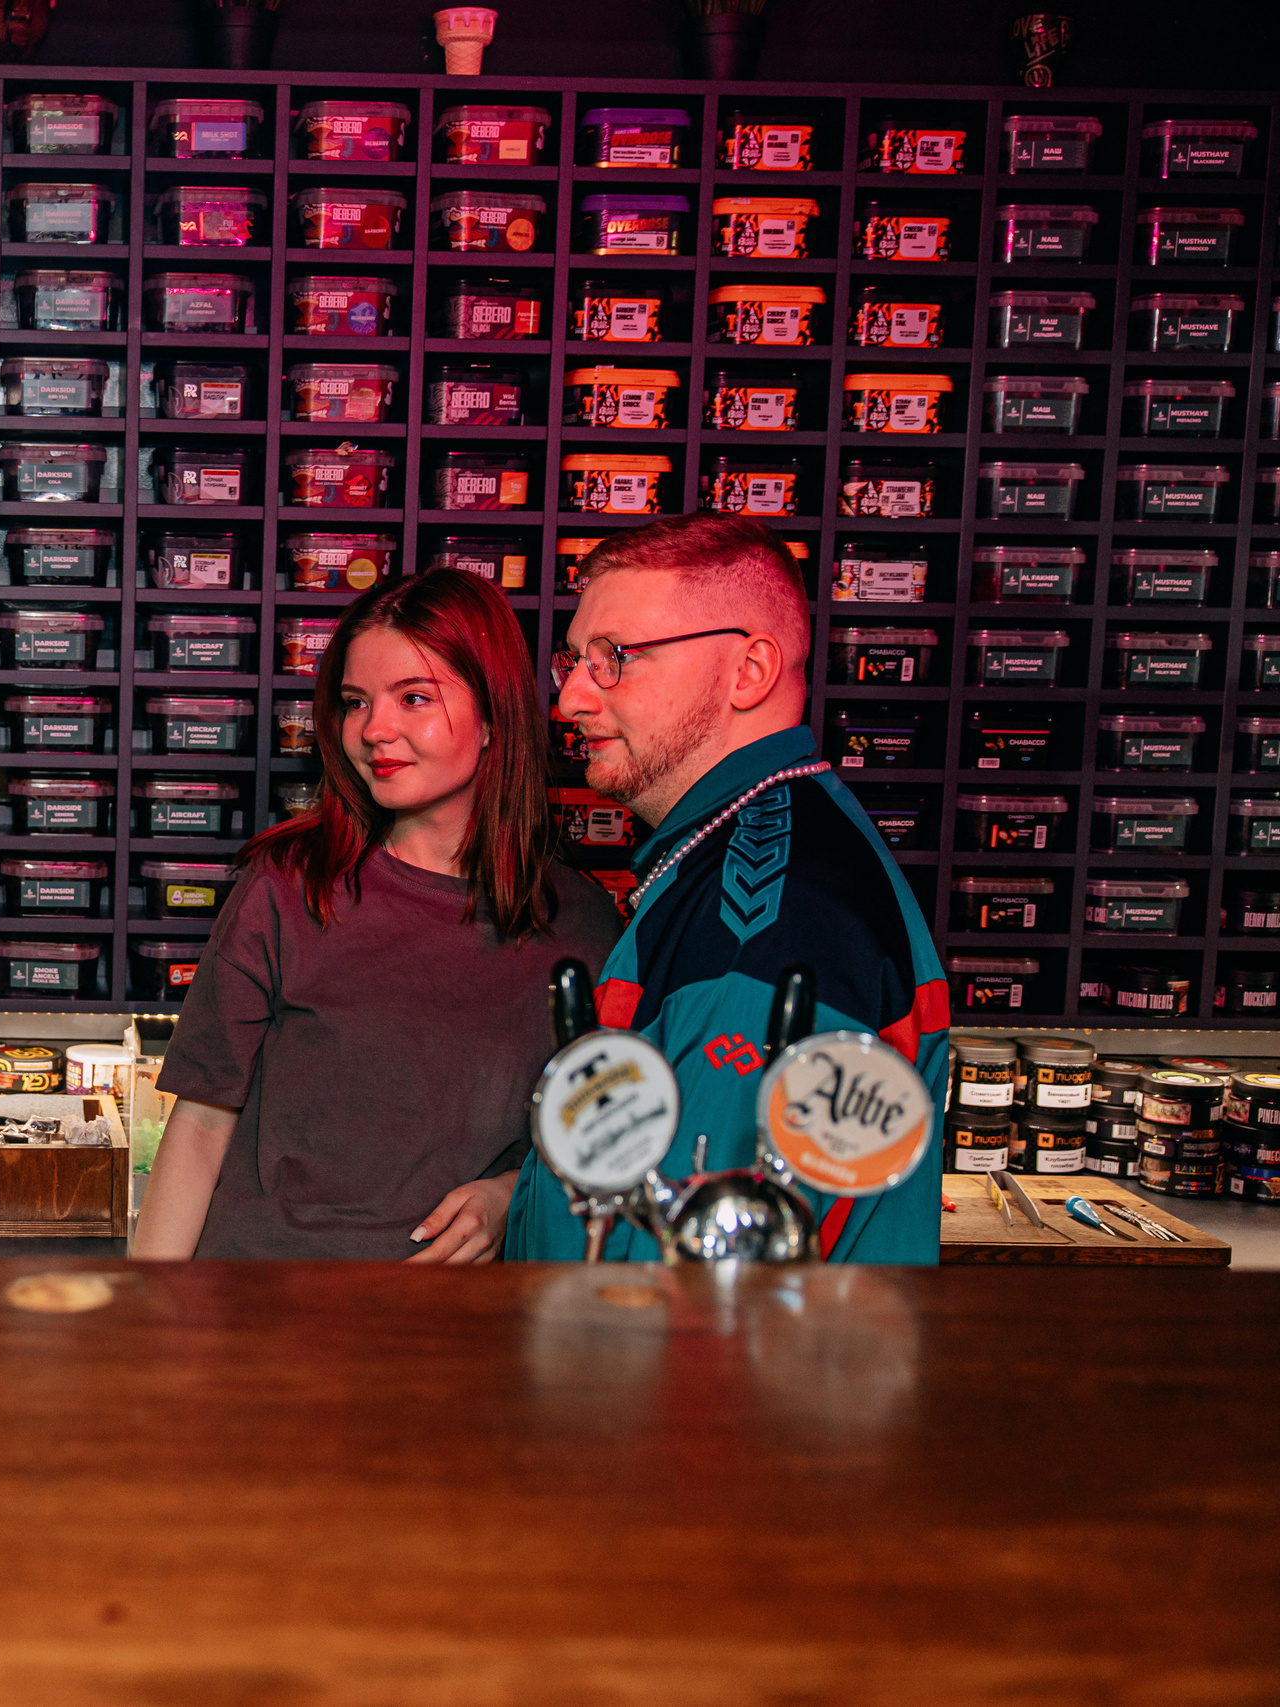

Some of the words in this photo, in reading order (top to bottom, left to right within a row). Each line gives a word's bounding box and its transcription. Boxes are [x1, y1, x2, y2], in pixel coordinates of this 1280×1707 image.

[333, 121, 362, 133] SEBERO
[471, 126, 499, 137] SEBERO
[611, 132, 672, 146] OVERDOSE
[333, 209, 361, 221] SEBERO
[480, 212, 506, 224] SEBERO
[607, 217, 668, 232] OVERDOSE
[319, 296, 347, 308] SEBERO
[473, 306, 511, 323] SEBERO
[320, 382, 348, 395] SEBERO
[452, 392, 490, 408] SEBERO
[316, 469, 343, 481] SEBERO
[458, 478, 496, 494] SEBERO
[319, 554, 347, 565] SEBERO
[1244, 912, 1265, 927] BERRY
[1117, 991, 1147, 1008] UNICORN
[1149, 994, 1174, 1009] TREATS
[785, 1052, 909, 1137] Abbé
